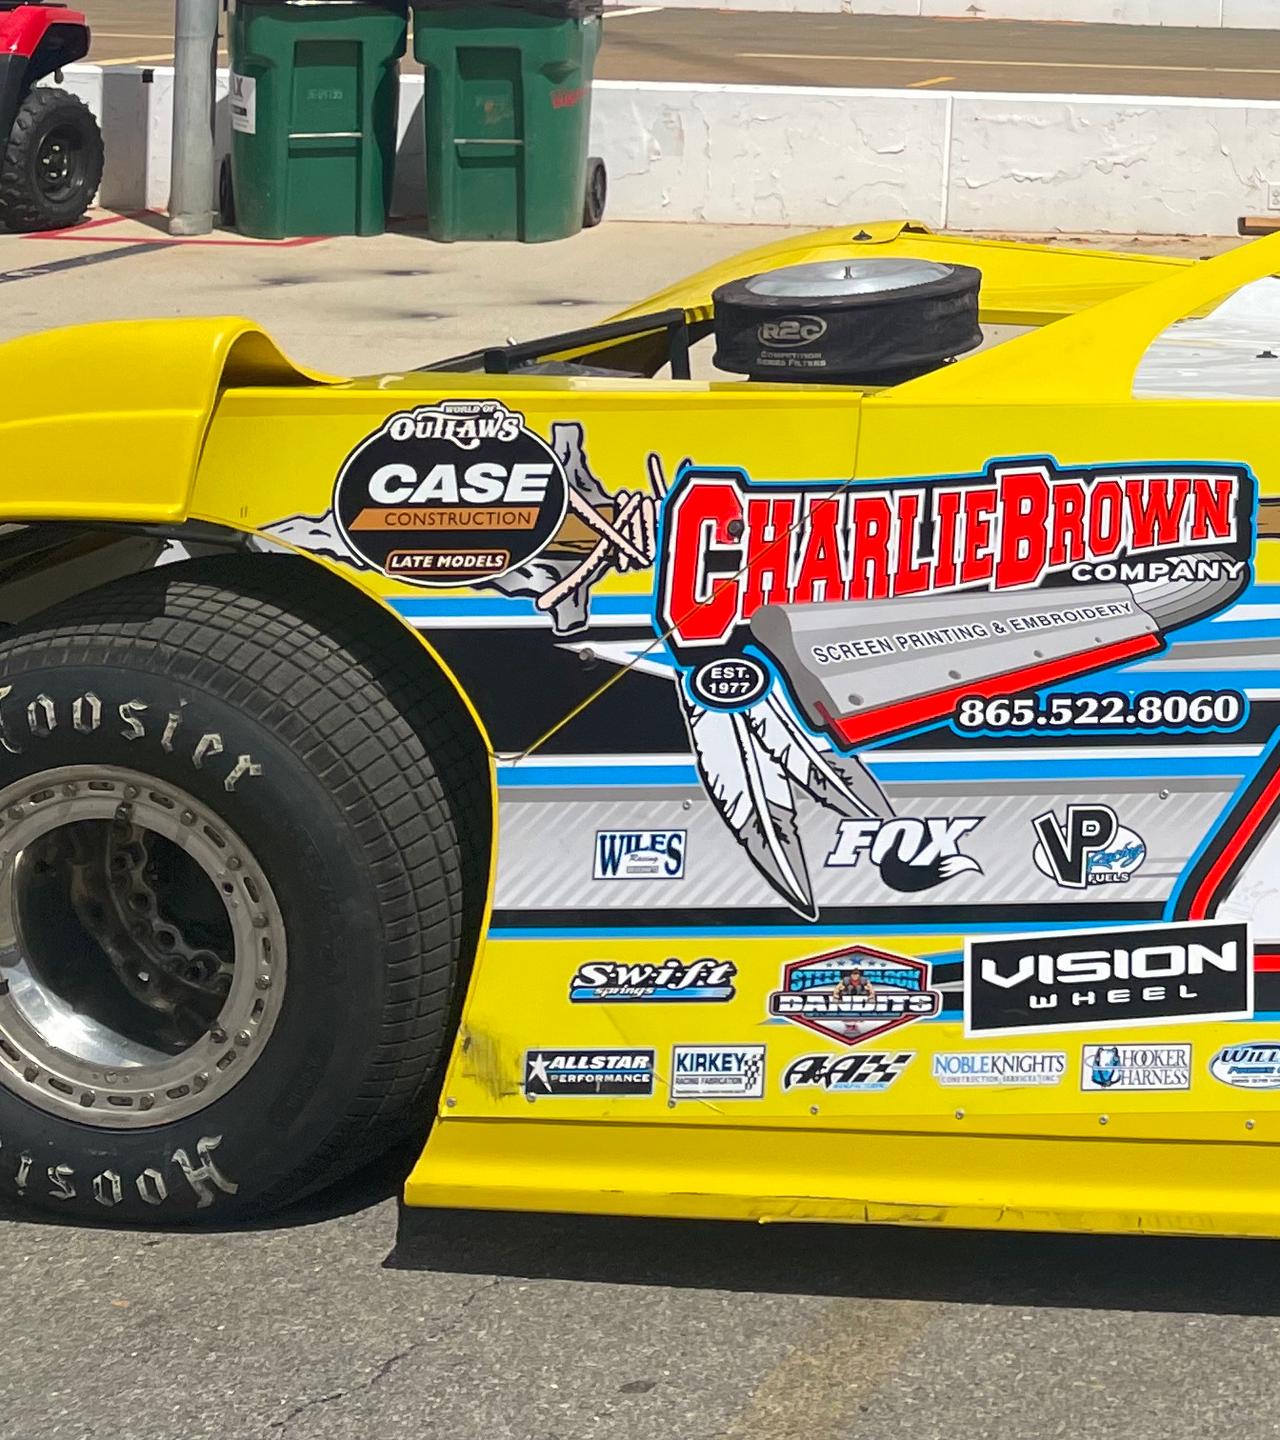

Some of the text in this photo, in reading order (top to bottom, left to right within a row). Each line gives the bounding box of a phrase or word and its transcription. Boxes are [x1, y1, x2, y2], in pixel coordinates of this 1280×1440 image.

[762, 320, 821, 340] R2C
[368, 462, 554, 504] CASE
[384, 511, 532, 526] CONSTRUCTION
[391, 554, 505, 569] LATE MODELS
[1071, 559, 1245, 583] COMPANY
[811, 600, 1134, 665] SCREEN PRINTING & EMBROIDERY
[709, 667, 750, 681] EST.
[707, 681, 751, 695] 1977
[957, 695, 1240, 728] 865.522.8060
[824, 816, 986, 869] FOX
[1032, 803, 1119, 889] VP
[599, 833, 682, 876] WILES
[1087, 871, 1131, 883] FUELS
[980, 940, 1238, 988] VISION
[593, 986, 655, 998] springs
[1028, 983, 1198, 1009] WHEEL
[777, 993, 934, 1013] BANDITS
[547, 1055, 650, 1070] ALLSTAR
[676, 1052, 746, 1072] KIRKEY
[1121, 1049, 1188, 1067] HOOKER
[550, 1074, 650, 1083] PERFORMANCE
[1120, 1068, 1189, 1086] HARNESS
